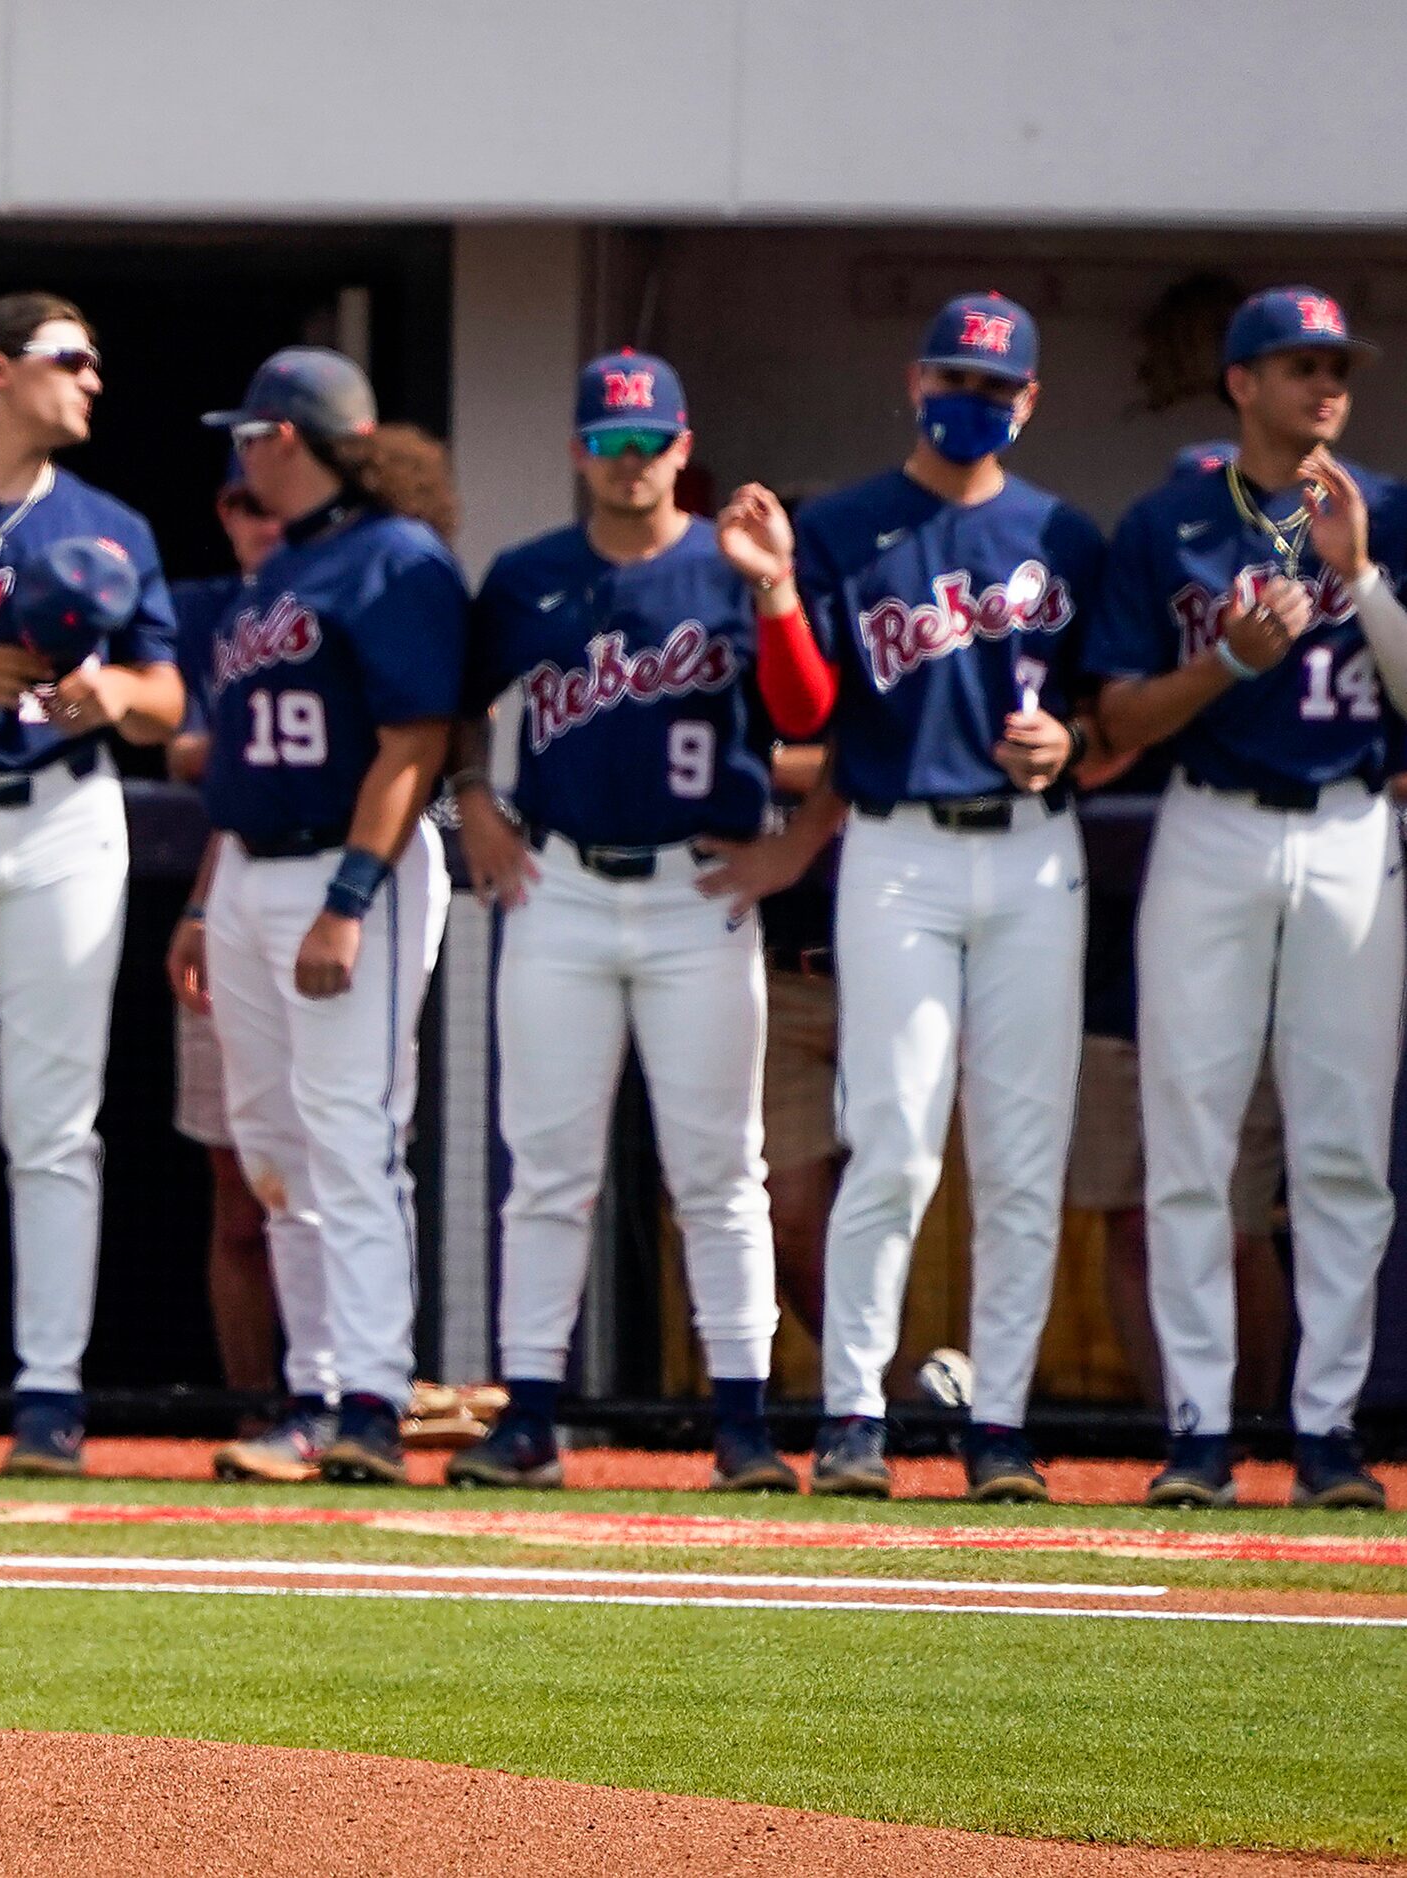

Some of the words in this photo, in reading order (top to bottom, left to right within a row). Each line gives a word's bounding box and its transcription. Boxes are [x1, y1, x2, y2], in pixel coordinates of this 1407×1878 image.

[961, 312, 1014, 352] M
[604, 371, 654, 408] M
[859, 557, 1074, 693] Rebels
[524, 619, 739, 754] Rebels
[1300, 648, 1381, 720] 14
[244, 688, 328, 767] 19
[667, 719, 715, 798] 9
